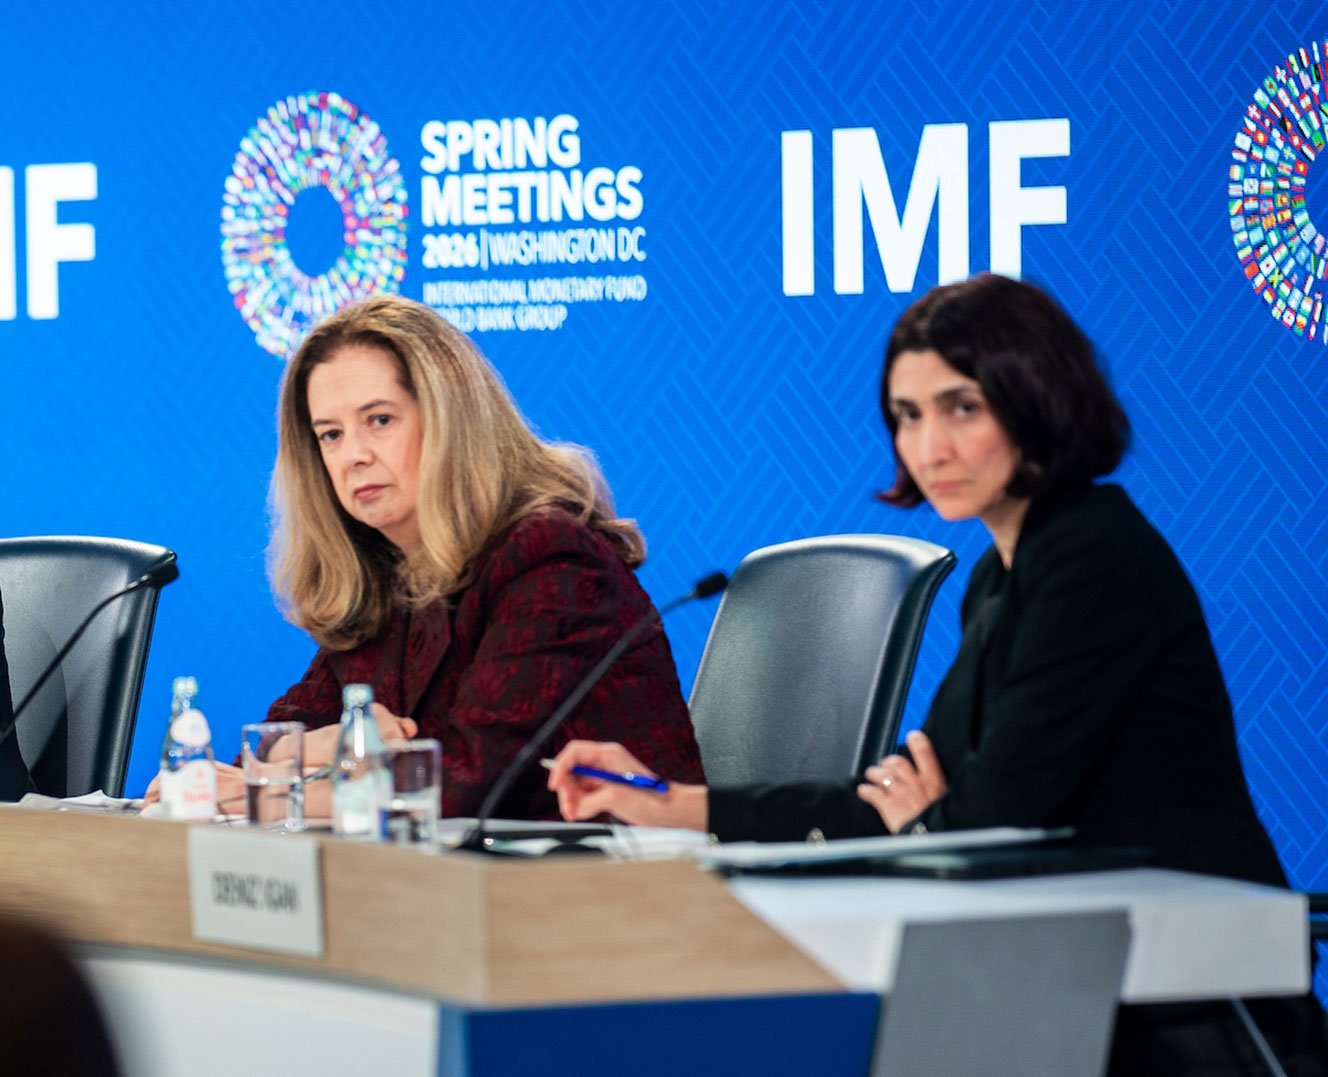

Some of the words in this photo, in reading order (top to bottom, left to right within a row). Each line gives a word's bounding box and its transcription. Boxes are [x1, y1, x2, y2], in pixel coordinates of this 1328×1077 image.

[420, 114, 581, 173] SPRING
[421, 166, 644, 226] MEETINGS
[781, 118, 1071, 296] IMF
[422, 232, 479, 268] 2026
[488, 228, 615, 266] WASHINGTON
[617, 226, 647, 262] DC
[605, 275, 648, 302] FUND
